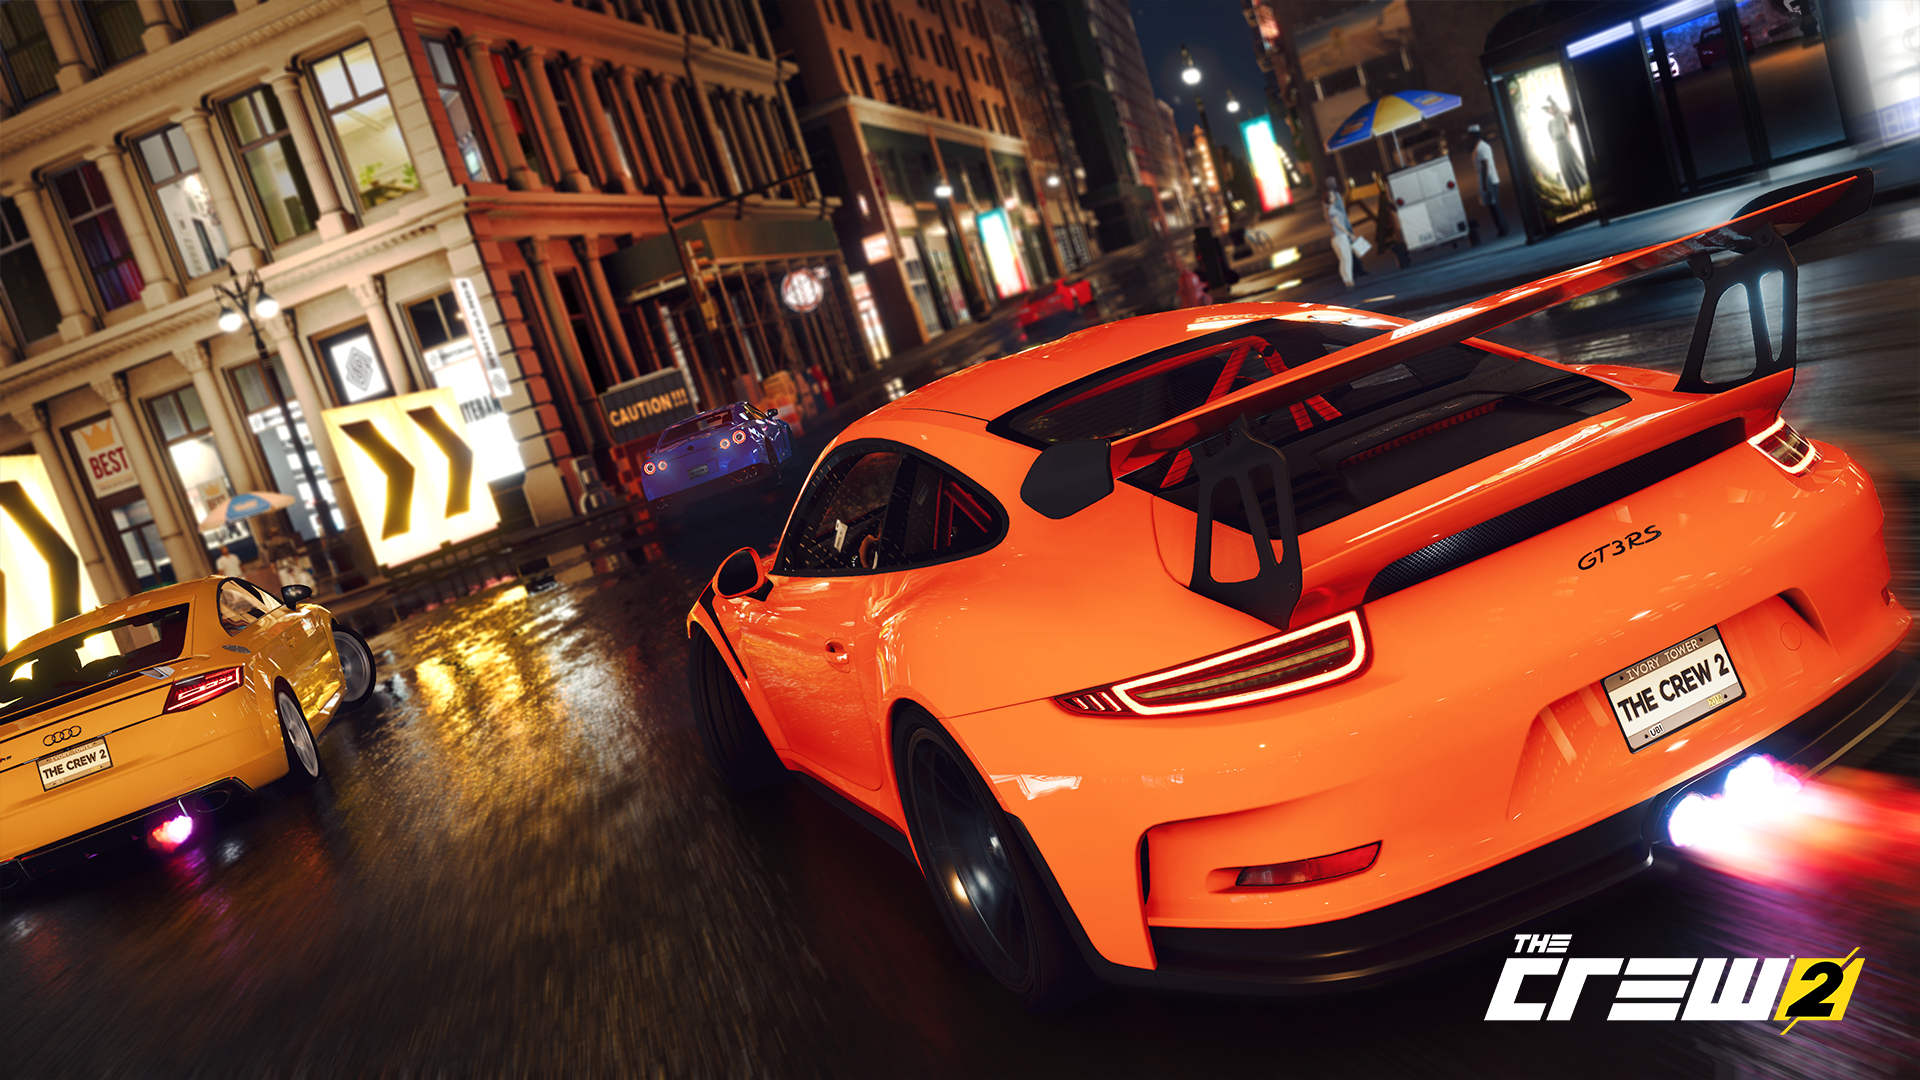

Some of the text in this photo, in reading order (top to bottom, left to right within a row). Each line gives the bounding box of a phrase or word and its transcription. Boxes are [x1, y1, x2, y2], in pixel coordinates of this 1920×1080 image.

[88, 447, 130, 480] BEST
[1626, 638, 1699, 681] IVORY TOWER
[1617, 653, 1730, 722] THE CREW 2
[1649, 724, 1664, 737] UBI
[42, 764, 65, 779] THE
[66, 752, 97, 770] CREW
[99, 749, 107, 760] 2
